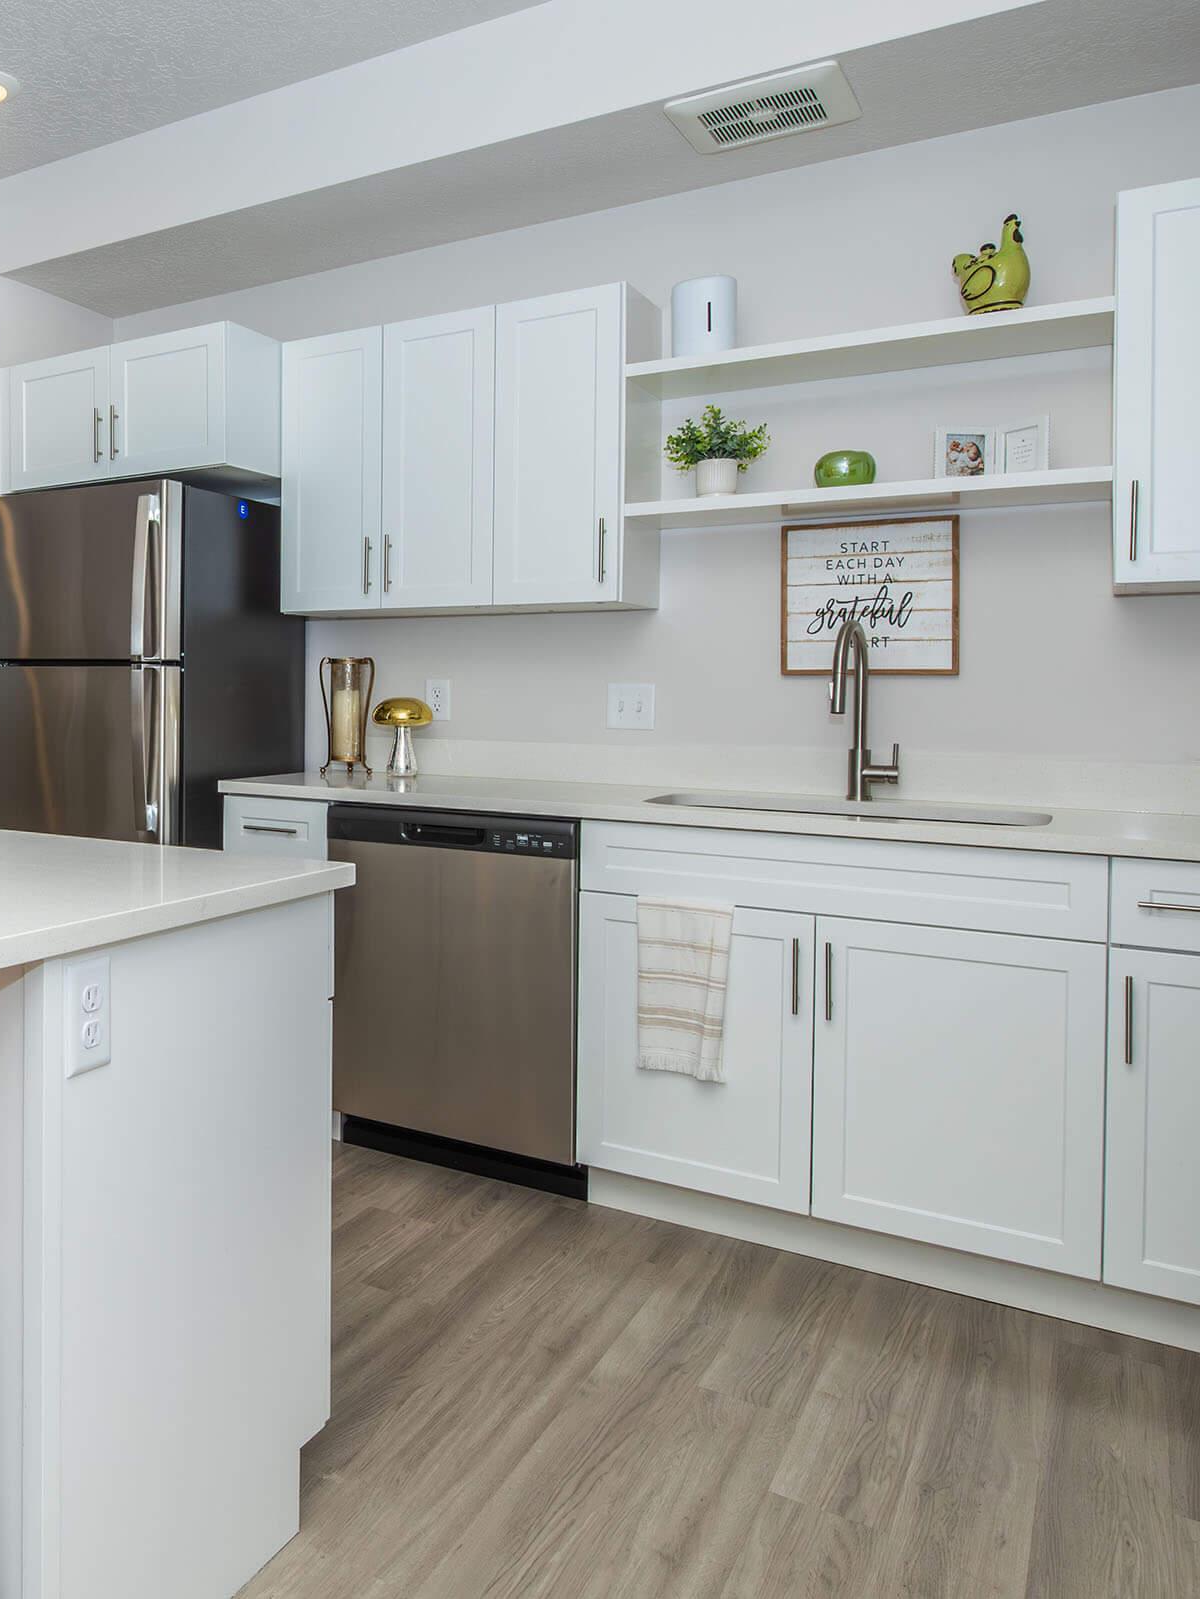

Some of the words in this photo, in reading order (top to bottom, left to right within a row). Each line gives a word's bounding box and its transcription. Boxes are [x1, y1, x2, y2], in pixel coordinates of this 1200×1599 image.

[840, 540, 890, 553] START
[826, 559, 866, 570] EACH
[873, 557, 905, 569] DAY
[837, 574, 877, 585] WITH
[883, 573, 893, 584] A
[806, 585, 913, 635] grateful
